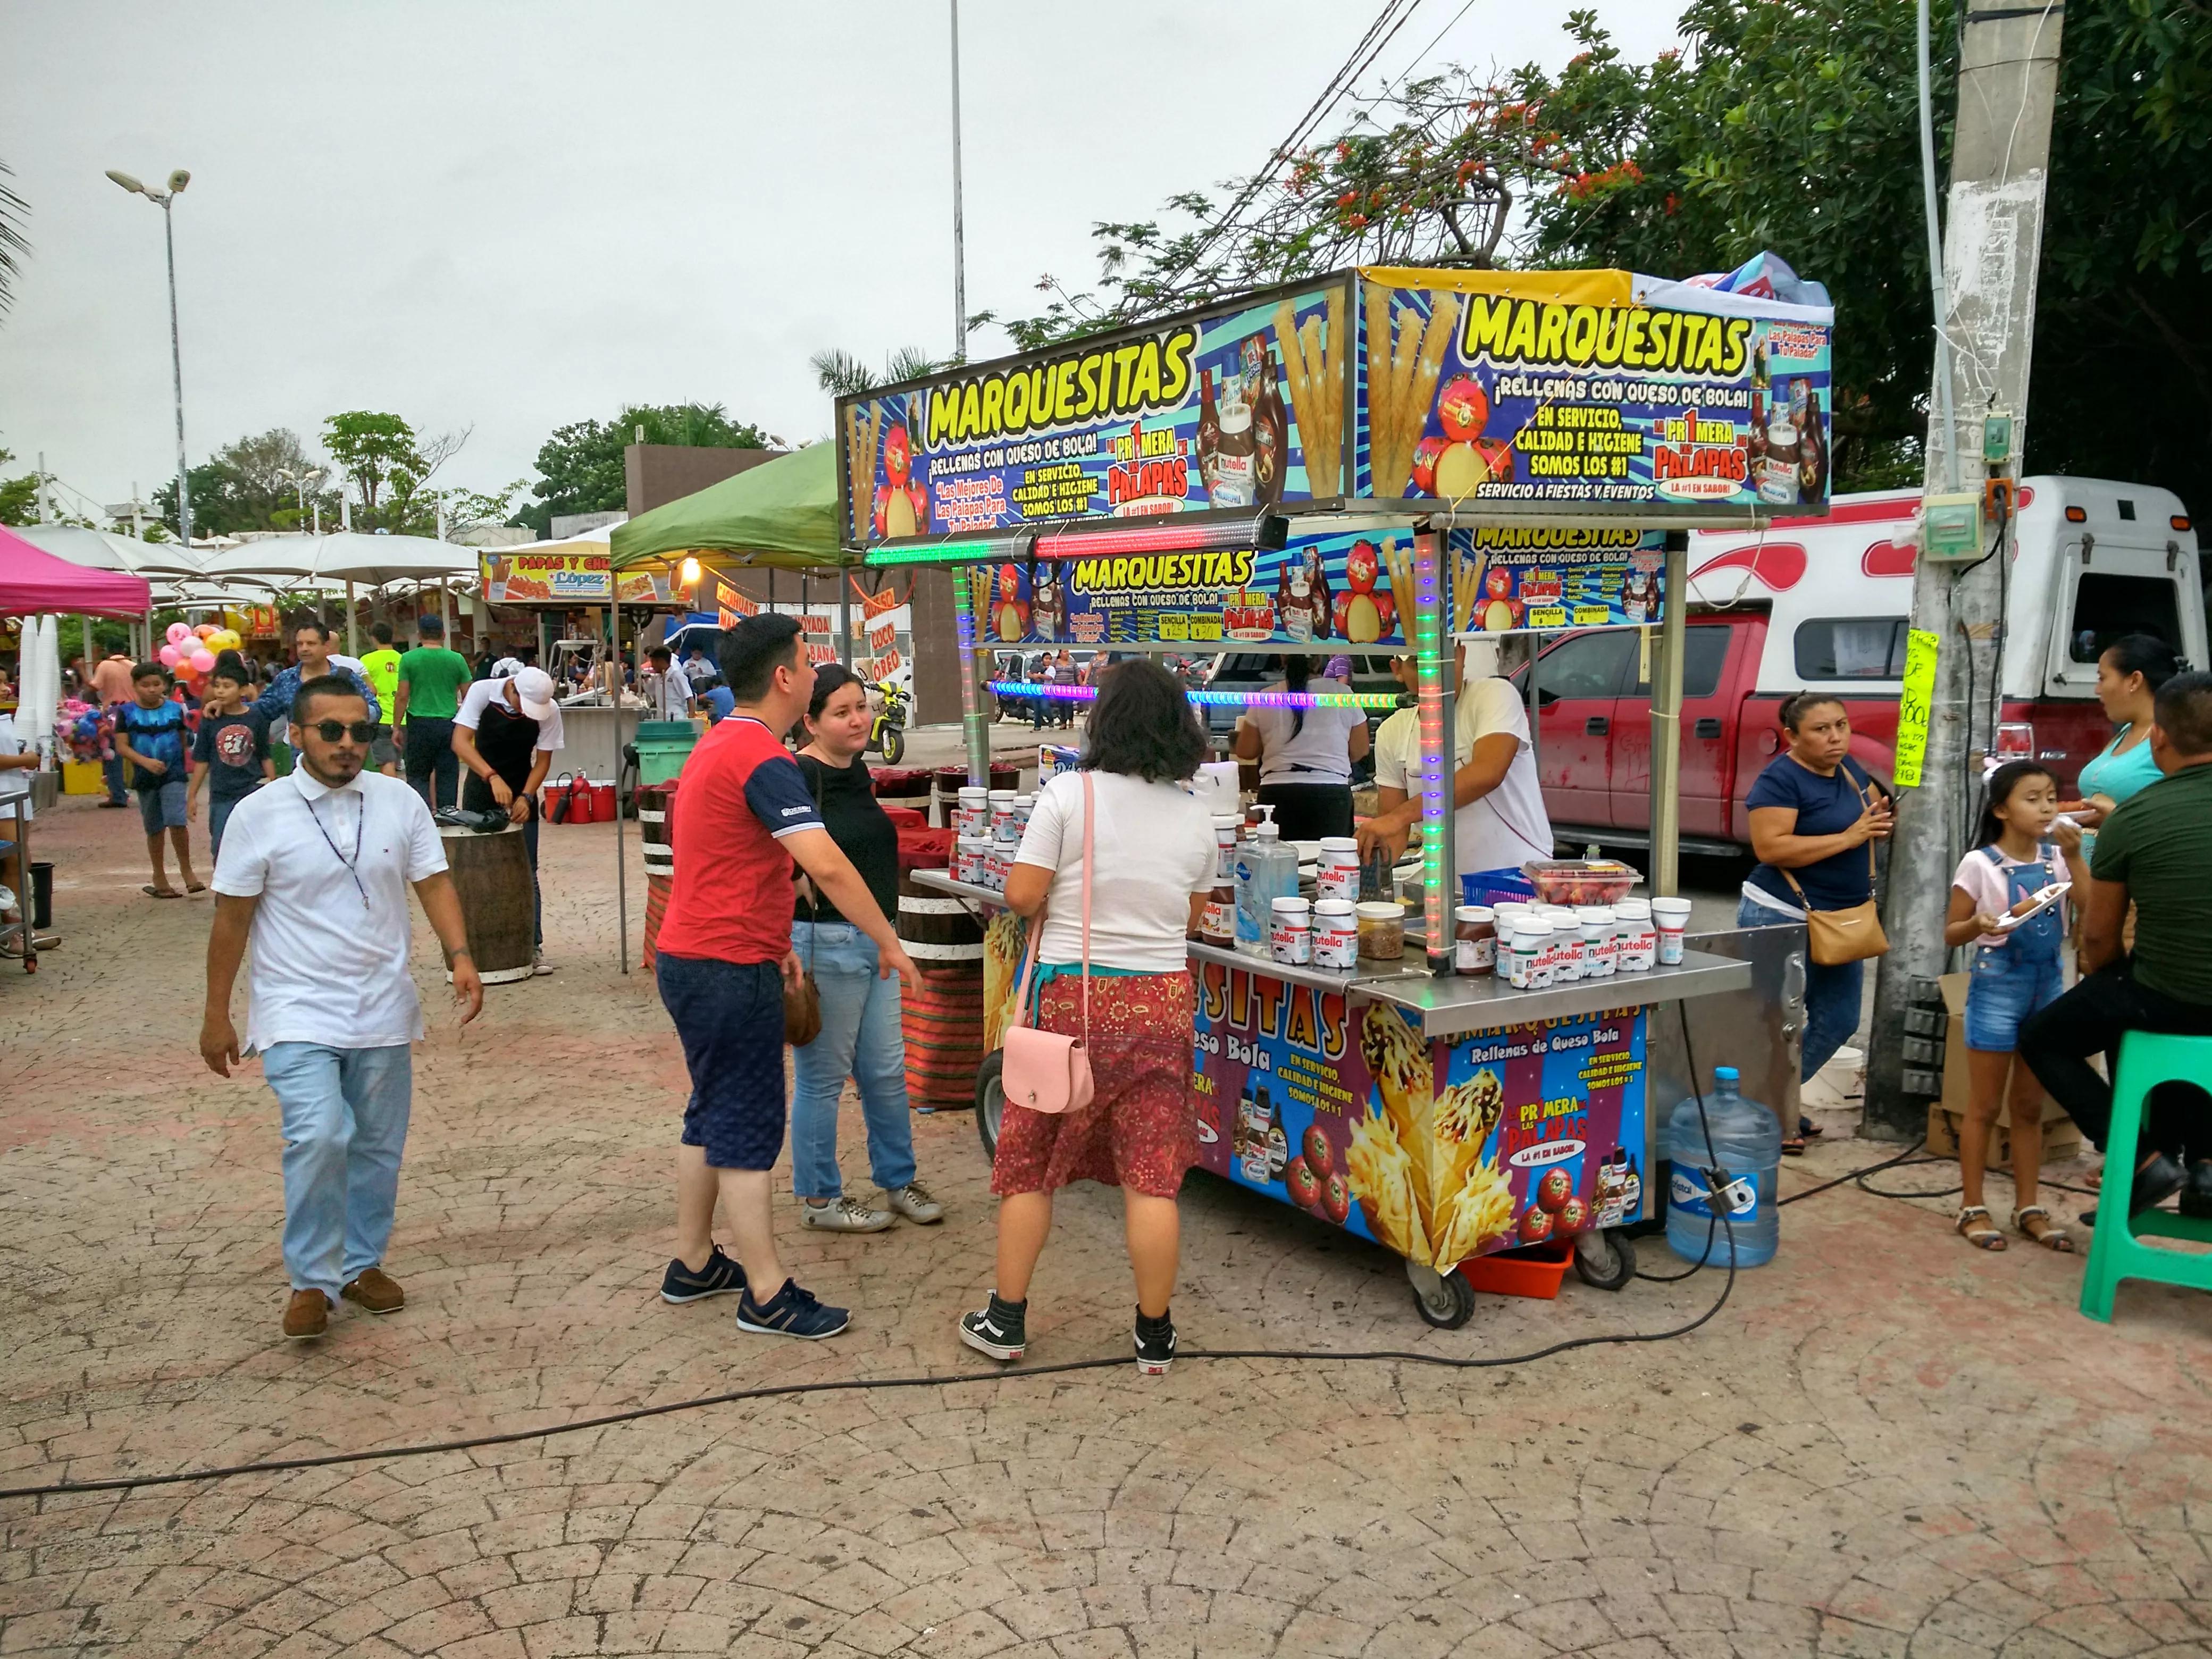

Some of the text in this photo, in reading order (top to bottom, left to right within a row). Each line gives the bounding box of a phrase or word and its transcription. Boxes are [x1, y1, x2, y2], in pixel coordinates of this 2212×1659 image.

[1466, 297, 1748, 370] MARQUESITAS
[929, 332, 1193, 442] MARQUESITAS
[1495, 377, 1747, 408] ¡RELLENAS CON QUESO DE BOLA!
[1538, 407, 1621, 430] EN SERVICIO,
[984, 449, 1003, 468] CON
[1007, 443, 1041, 464] QUESO
[1043, 439, 1059, 459] DE
[1062, 433, 1097, 457] BOLA!
[1516, 431, 1641, 453] CALIDAD E HIGIENE
[1221, 456, 1246, 472] nutella
[1530, 455, 1627, 476] SOMOS LOS #1
[1655, 446, 1746, 482] PALAPAS
[1025, 464, 1083, 484] EN SERVICIO,
[1109, 458, 1187, 504] PALAPAS
[956, 477, 988, 499] Mejores
[991, 476, 1003, 493] De
[1012, 477, 1098, 501] CALIDAD E HIGIENE
[1478, 483, 1654, 499] SERVICIO A FIESTAS Y EVENTOS
[1671, 483, 1679, 492] LA
[1692, 484, 1702, 492] EN
[1703, 484, 1730, 493] SABOR!
[936, 497, 1006, 520] Las Palapas Para
[1023, 497, 1088, 516] SOMOS LOS #1
[518, 557, 564, 569] PAPAS
[569, 557, 579, 569] Y
[1540, 555, 1557, 564] CON
[1559, 553, 1587, 564] QUESO
[1589, 552, 1601, 563] DE
[1603, 551, 1628, 562] BOLA!
[554, 572, 604, 587] López
[1076, 551, 1253, 589] MARQUESITAS
[1132, 594, 1147, 607] CON
[1150, 593, 1177, 607] QUESO
[1178, 593, 1190, 606] DE
[1192, 592, 1218, 606] BOLA!
[1191, 616, 1221, 624] COMBINADA
[872, 624, 894, 650] COCO
[873, 650, 899, 682] OREO
[1317, 871, 1345, 883] nutella
[1312, 935, 1343, 948] nutella
[1589, 943, 1617, 958] nutella
[1616, 940, 1652, 952] nutella
[1526, 956, 1554, 969] nutella
[1554, 949, 1582, 961] utella
[1226, 1034, 1270, 1071] Bola
[1471, 1028, 1619, 1063] Rellenas de Queso Bola
[1291, 1053, 1301, 1066] EN
[1589, 1057, 1598, 1065] EN
[1578, 1061, 1642, 1079] CALIDAD E HIGIENE
[1278, 1067, 1353, 1104] CALIDAD E HIGIENE
[1587, 1077, 1623, 1090] SOMOS LOS
[1288, 1086, 1315, 1107] SOMOS
[1316, 1097, 1330, 1112] LOS
[1522, 1121, 1534, 1130] LAS
[1508, 1116, 1587, 1155] PALAPAS
[1522, 1153, 1530, 1162] LA
[1533, 1151, 1540, 1159] #1
